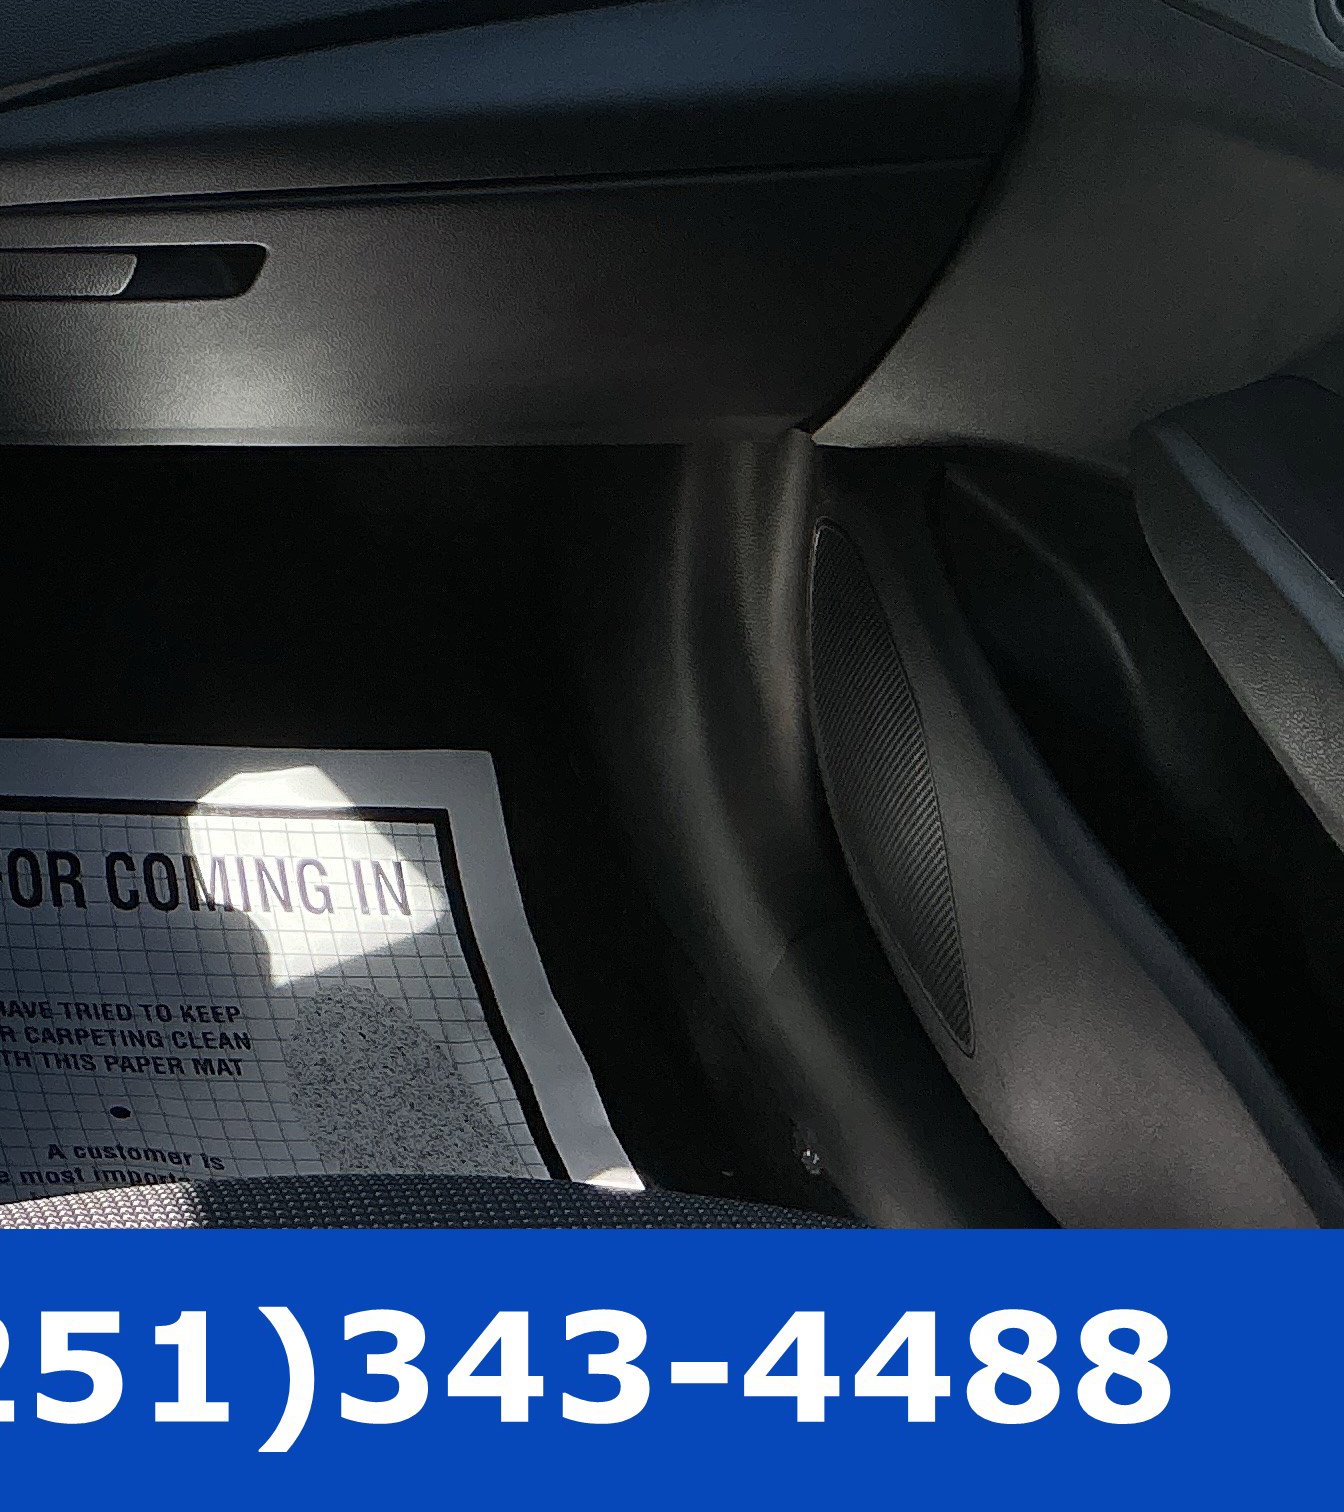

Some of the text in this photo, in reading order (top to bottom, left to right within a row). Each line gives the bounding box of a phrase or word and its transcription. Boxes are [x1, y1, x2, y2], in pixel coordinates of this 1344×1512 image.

[106, 850, 336, 916] COMING
[352, 858, 414, 917] IN
[58, 1001, 133, 1023] TRIED
[138, 1004, 173, 1024] TO
[179, 1004, 242, 1025] KEEP
[23, 1025, 165, 1050] CARPETING
[172, 1030, 252, 1052] CLEAN
[40, 1051, 97, 1072] THIS
[103, 1054, 185, 1076] PAPER
[191, 1056, 244, 1077] MAT
[47, 1143, 227, 1172] A customer is
[18, 1166, 86, 1185] most
